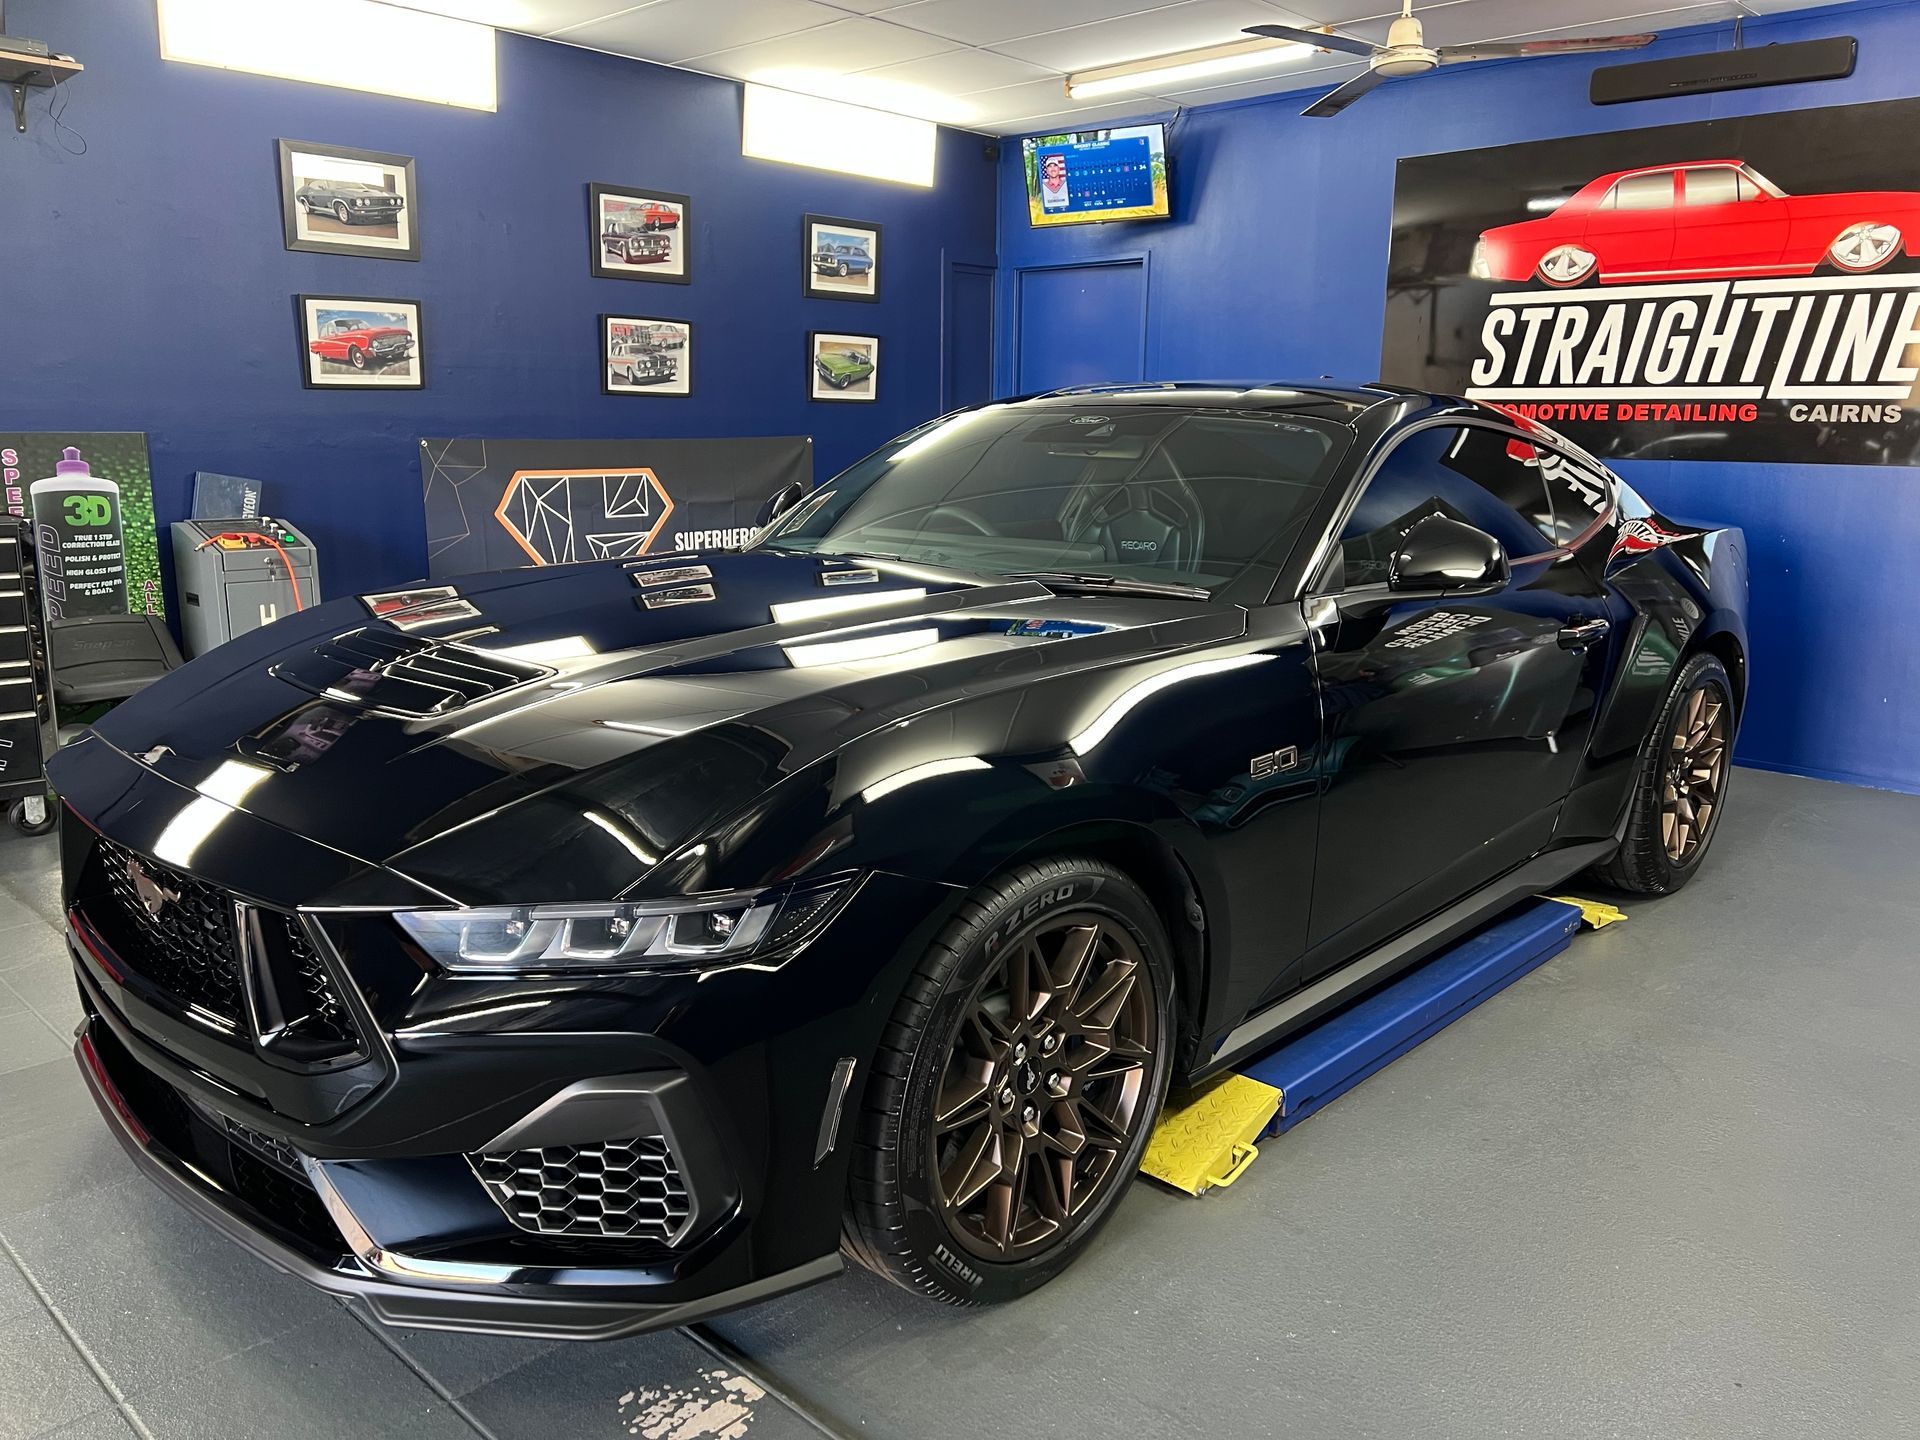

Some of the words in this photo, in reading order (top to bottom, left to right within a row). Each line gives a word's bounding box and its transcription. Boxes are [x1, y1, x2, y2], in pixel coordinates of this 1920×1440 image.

[1492, 404, 1610, 421] OMOTIVE
[1616, 403, 1758, 422] DETAILING
[1789, 404, 1902, 423] CAIRNS
[63, 495, 111, 526] 3D
[99, 533, 113, 541] STEP
[62, 541, 105, 549] CORRECTION
[1121, 540, 1157, 551] RECARO
[85, 567, 107, 575] GLOSS
[1250, 745, 1297, 781] 5.0
[1005, 883, 1075, 936] ZERO
